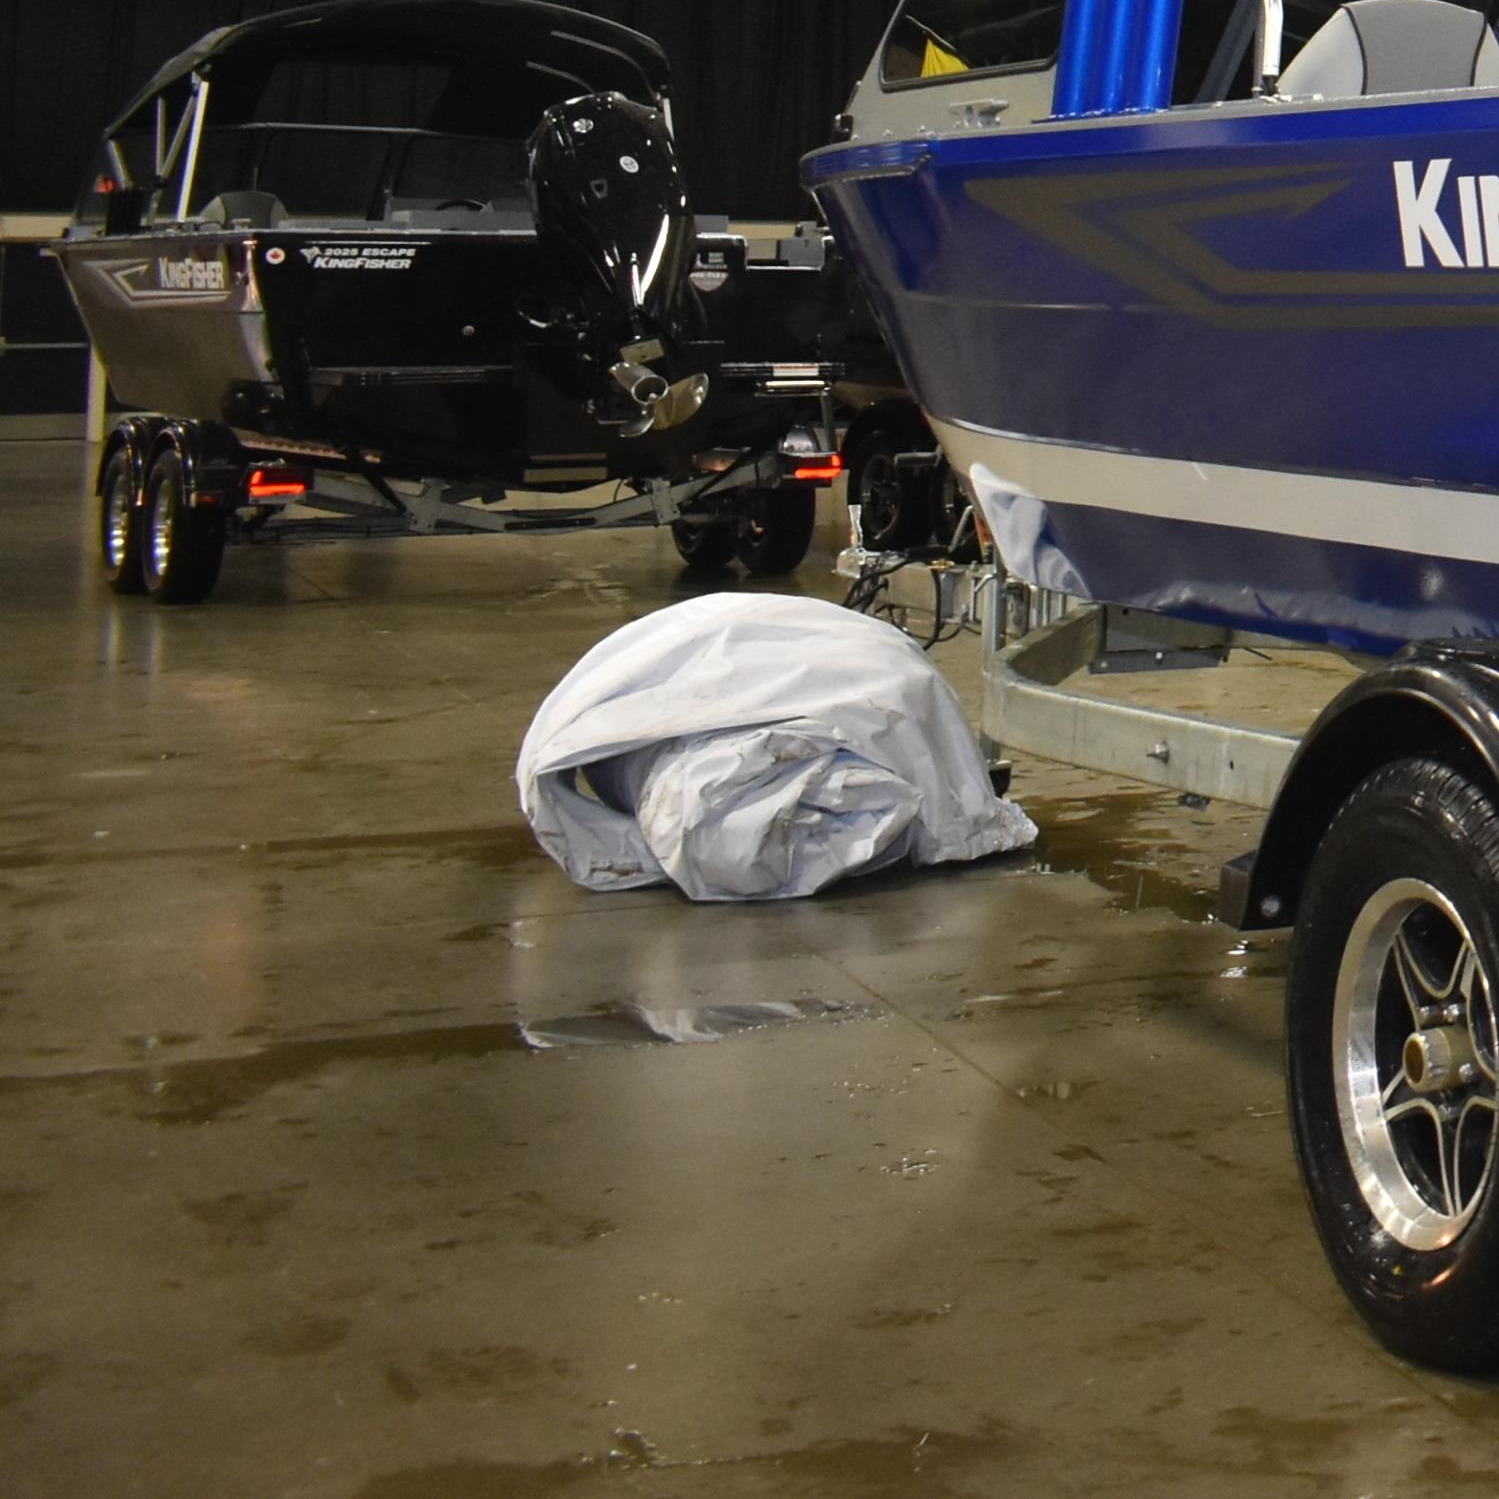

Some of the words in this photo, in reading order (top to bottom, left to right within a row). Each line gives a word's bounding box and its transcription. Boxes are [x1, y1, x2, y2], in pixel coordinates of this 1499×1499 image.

[324, 247, 359, 257] 2025
[361, 247, 416, 257] ESCAPE
[313, 257, 412, 269] KINGFISHER
